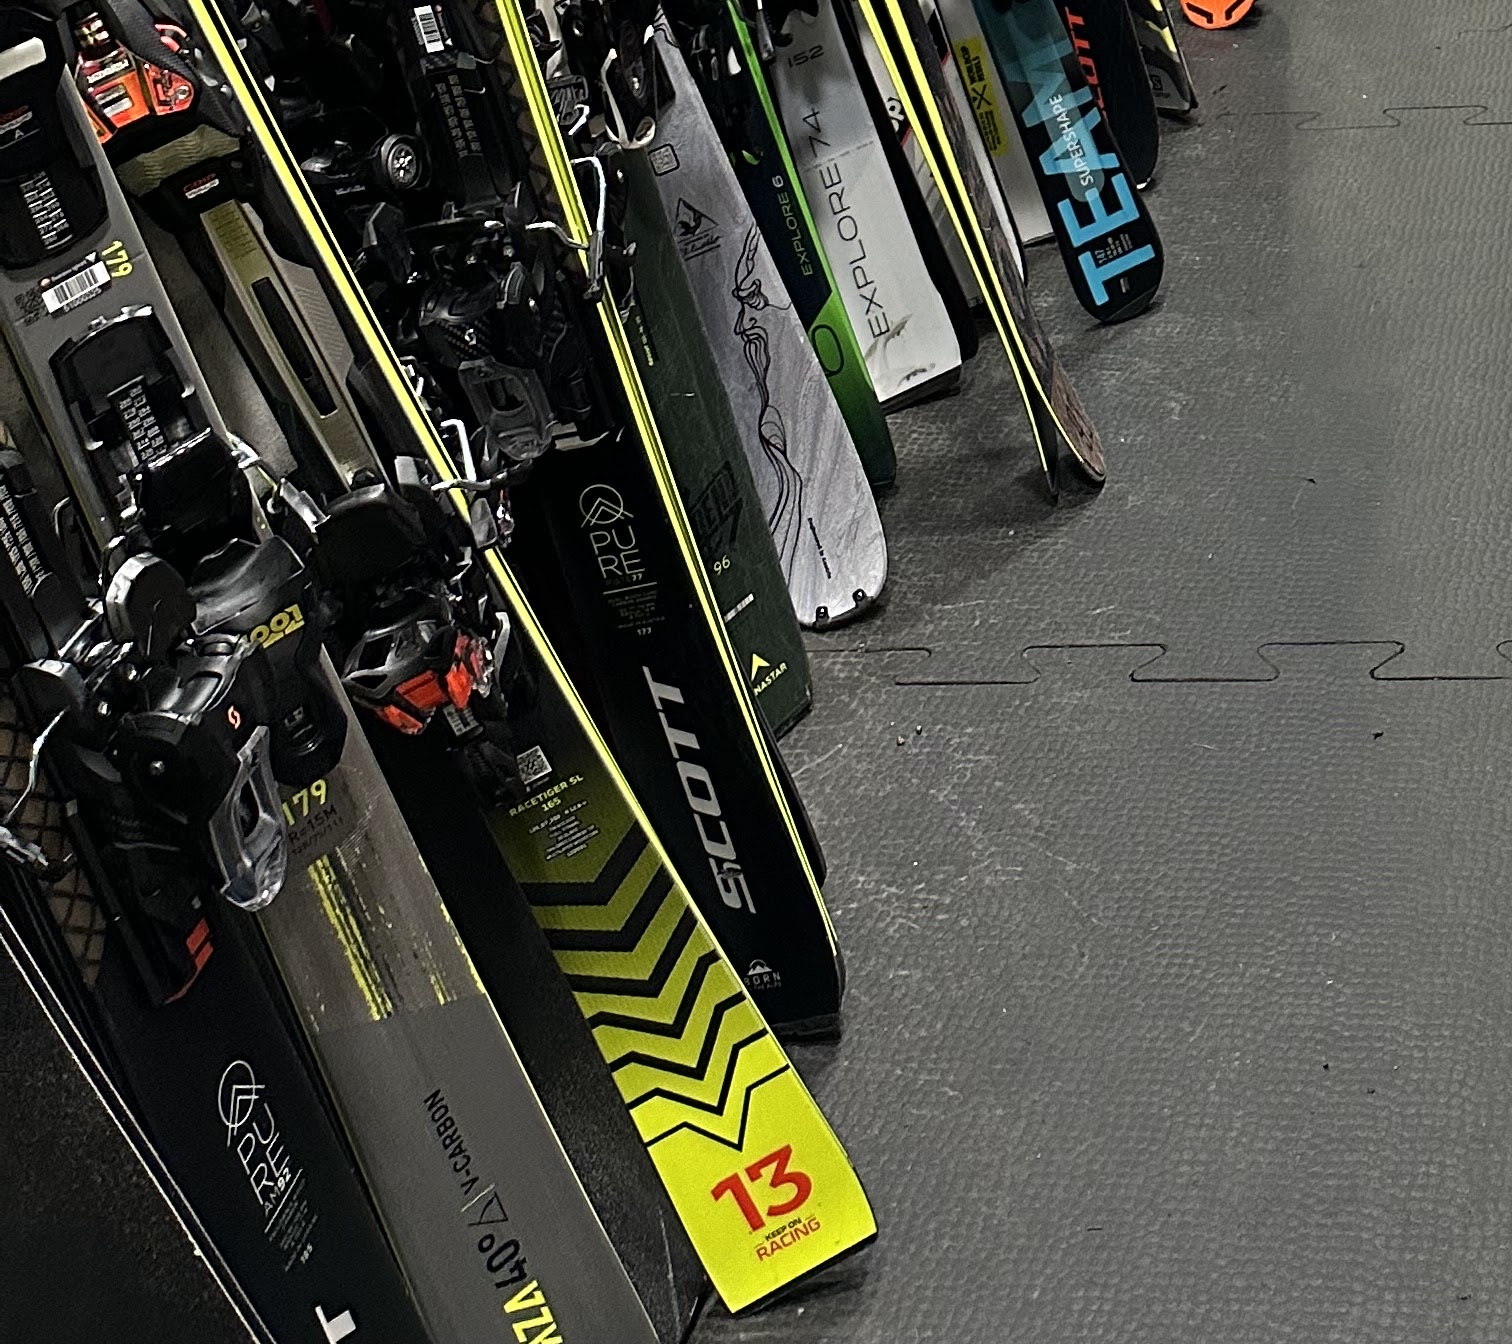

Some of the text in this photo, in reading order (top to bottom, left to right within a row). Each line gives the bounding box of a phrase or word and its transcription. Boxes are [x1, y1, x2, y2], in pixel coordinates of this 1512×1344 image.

[786, 44, 826, 70] 152
[1047, 92, 1096, 187] SUPERSHAPE
[777, 192, 815, 278] EXPLORE
[801, 107, 892, 340] EXPLORE 74
[100, 238, 135, 281] 179
[752, 660, 789, 697] NASTAR
[508, 772, 585, 818] RACETIGER SL
[541, 796, 563, 814] 165
[644, 664, 757, 916] SCOTT
[422, 1088, 480, 1196] V-CARBON
[710, 1143, 813, 1235] 13
[754, 1216, 822, 1262] RACING
[764, 1224, 789, 1244] KEEP
